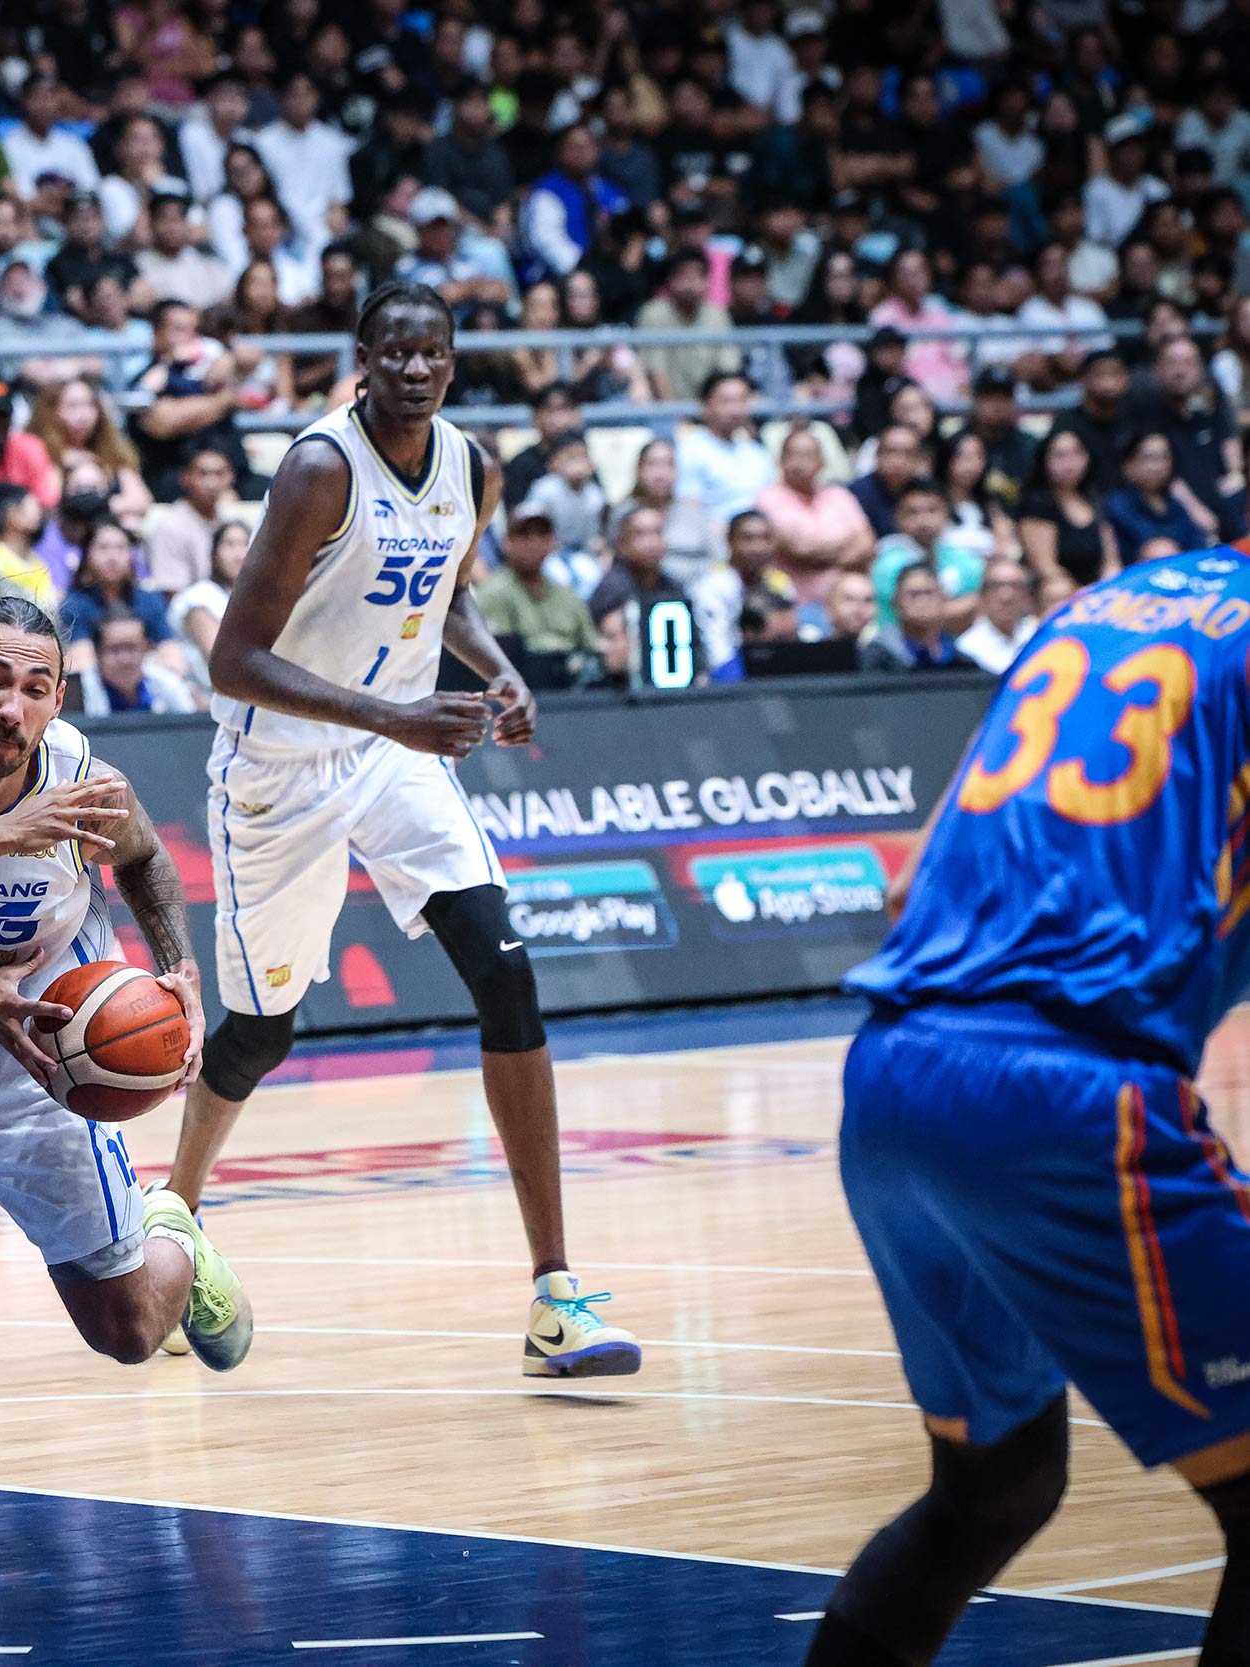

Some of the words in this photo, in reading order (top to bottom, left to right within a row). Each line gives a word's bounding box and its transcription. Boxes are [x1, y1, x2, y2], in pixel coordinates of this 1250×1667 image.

[377, 537, 455, 552] TROPANG
[364, 555, 448, 606] 5G
[362, 646, 390, 686] 1
[649, 601, 693, 689] 0
[955, 636, 1199, 827] 33
[469, 779, 703, 841] AVAILABLE
[698, 765, 917, 826] GLOBALLY
[162, 1027, 184, 1048] FIBA
